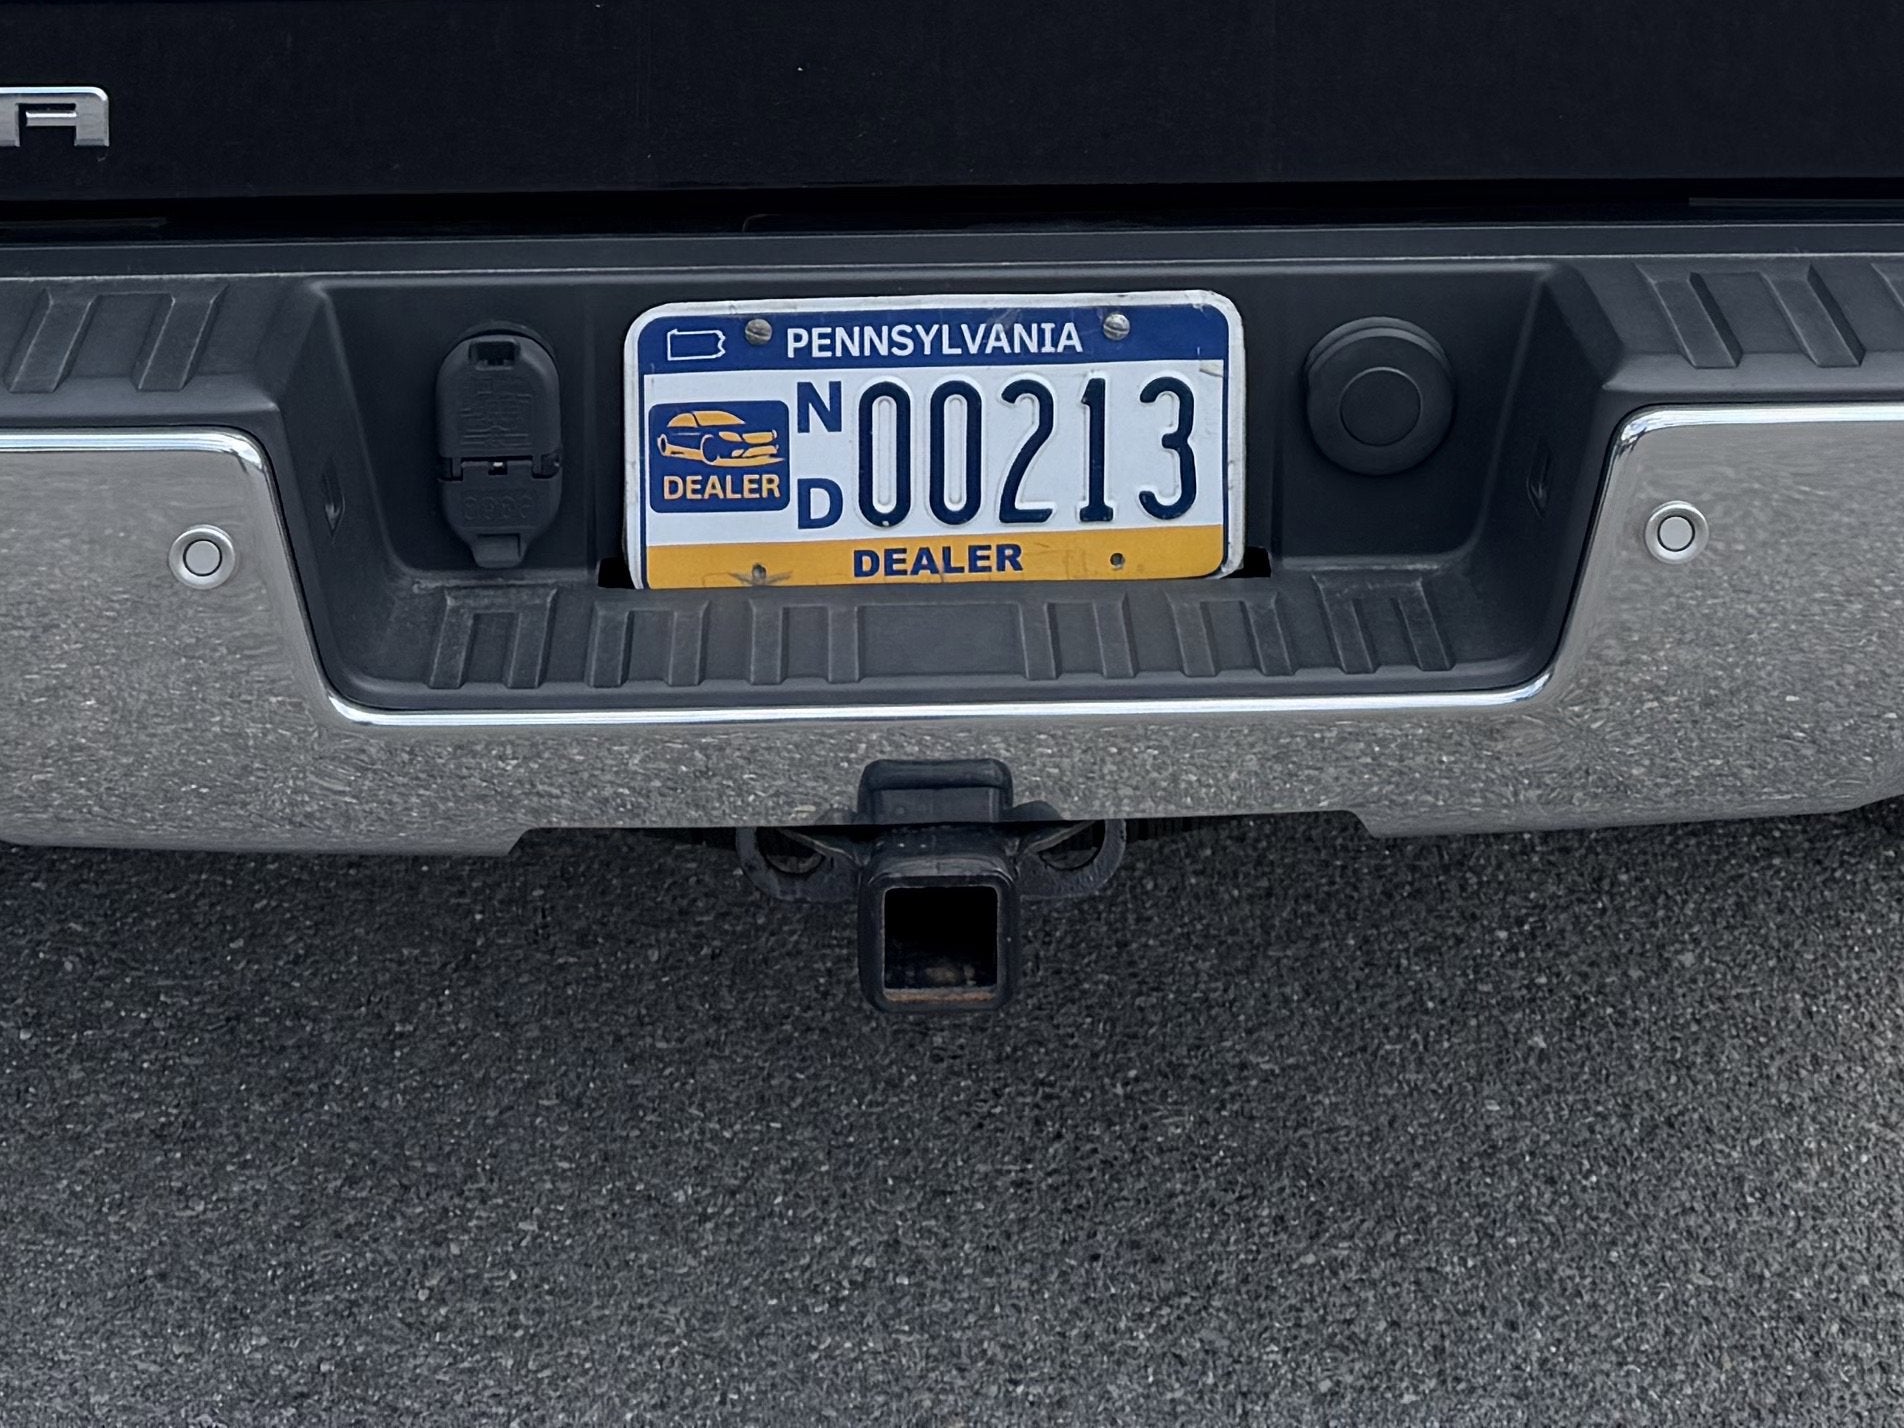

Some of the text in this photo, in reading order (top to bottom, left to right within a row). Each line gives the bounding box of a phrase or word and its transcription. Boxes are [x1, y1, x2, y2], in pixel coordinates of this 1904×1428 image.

[786, 321, 1084, 358] PENNSYLVANIA
[857, 376, 1197, 528] 00213
[663, 474, 781, 500] DEALER
[853, 543, 1024, 577] DEALER
